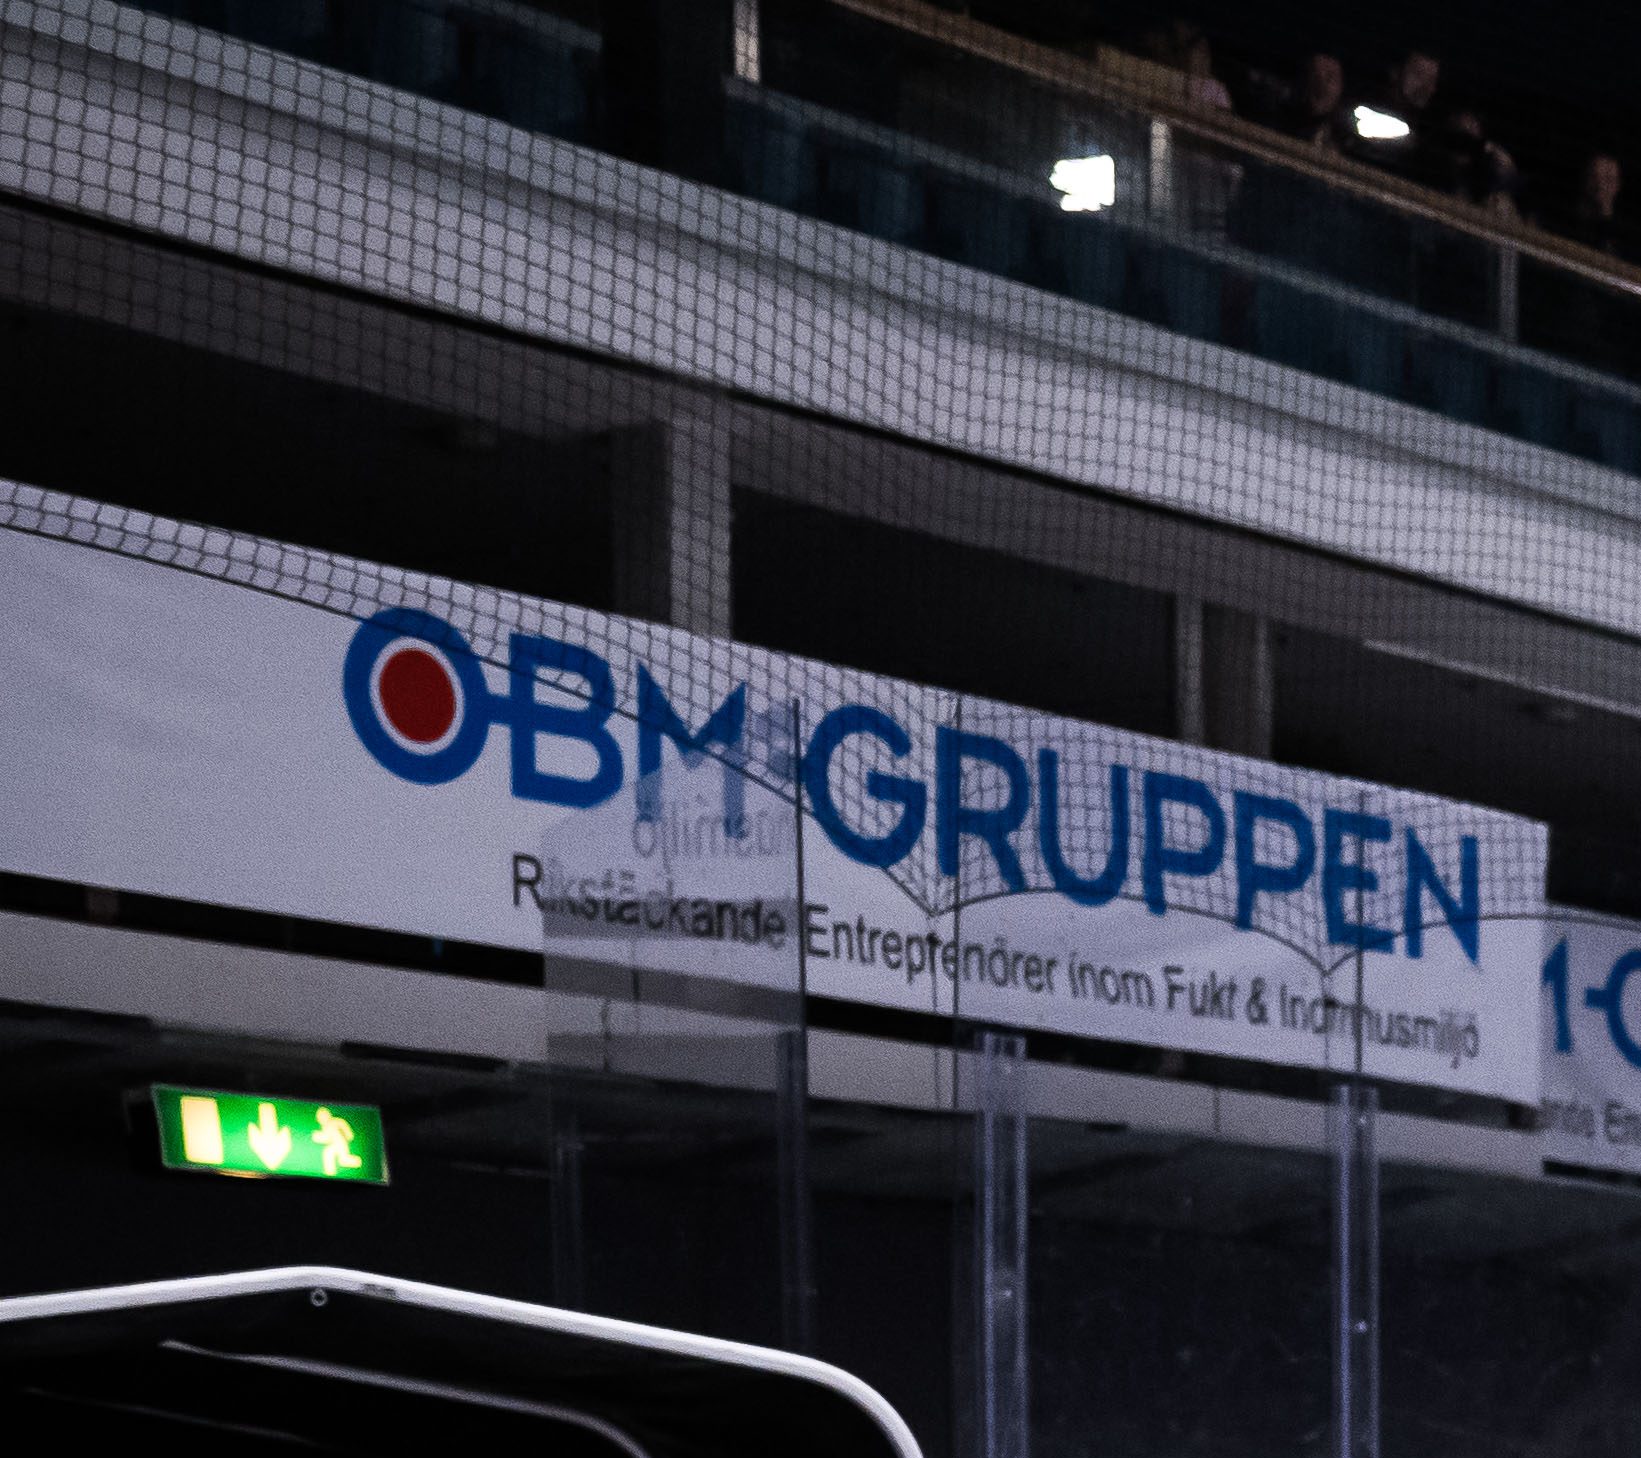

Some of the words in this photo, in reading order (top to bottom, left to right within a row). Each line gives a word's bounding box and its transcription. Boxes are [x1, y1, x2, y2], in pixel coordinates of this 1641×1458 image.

[1067, 951, 1154, 1009] inom
[1165, 966, 1236, 1021] Fukt
[1246, 984, 1269, 1032] &
